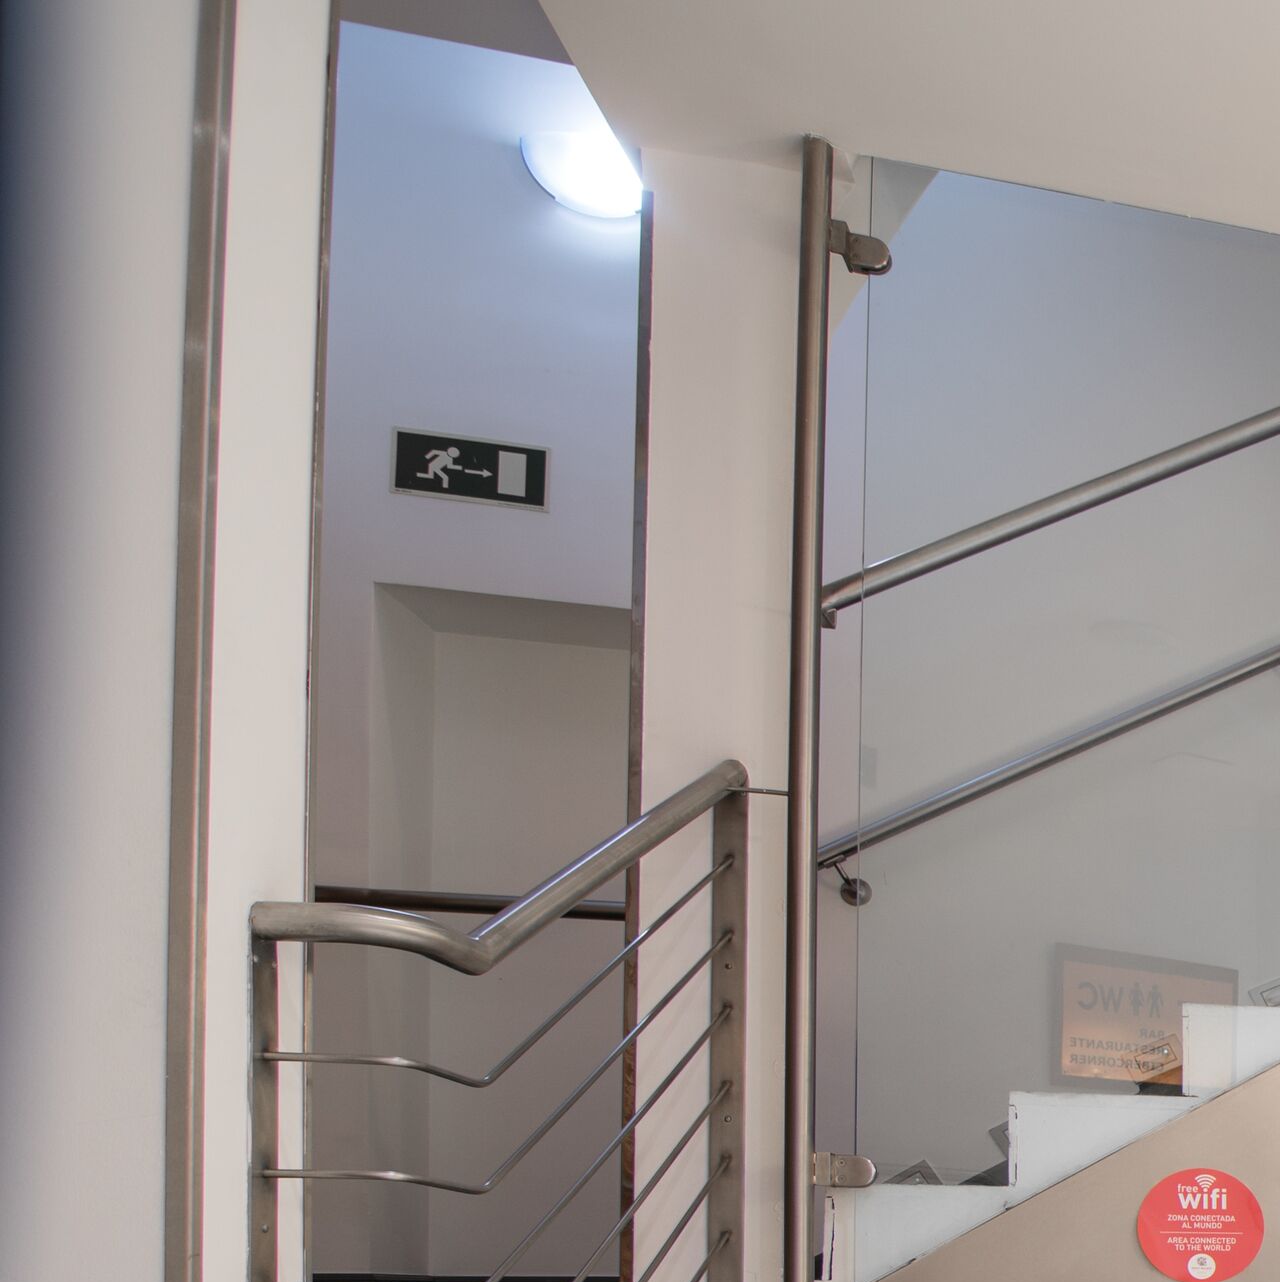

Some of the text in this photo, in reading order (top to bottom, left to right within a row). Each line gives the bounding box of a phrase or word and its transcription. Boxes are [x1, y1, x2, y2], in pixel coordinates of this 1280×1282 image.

[1177, 1183, 1199, 1193] free
[1178, 1188, 1227, 1210] wifi
[1167, 1214, 1236, 1223] ZONA CONECTADA
[1167, 1236, 1237, 1245] AREA CONNECTED
[1203, 1244, 1232, 1252] WORLD
